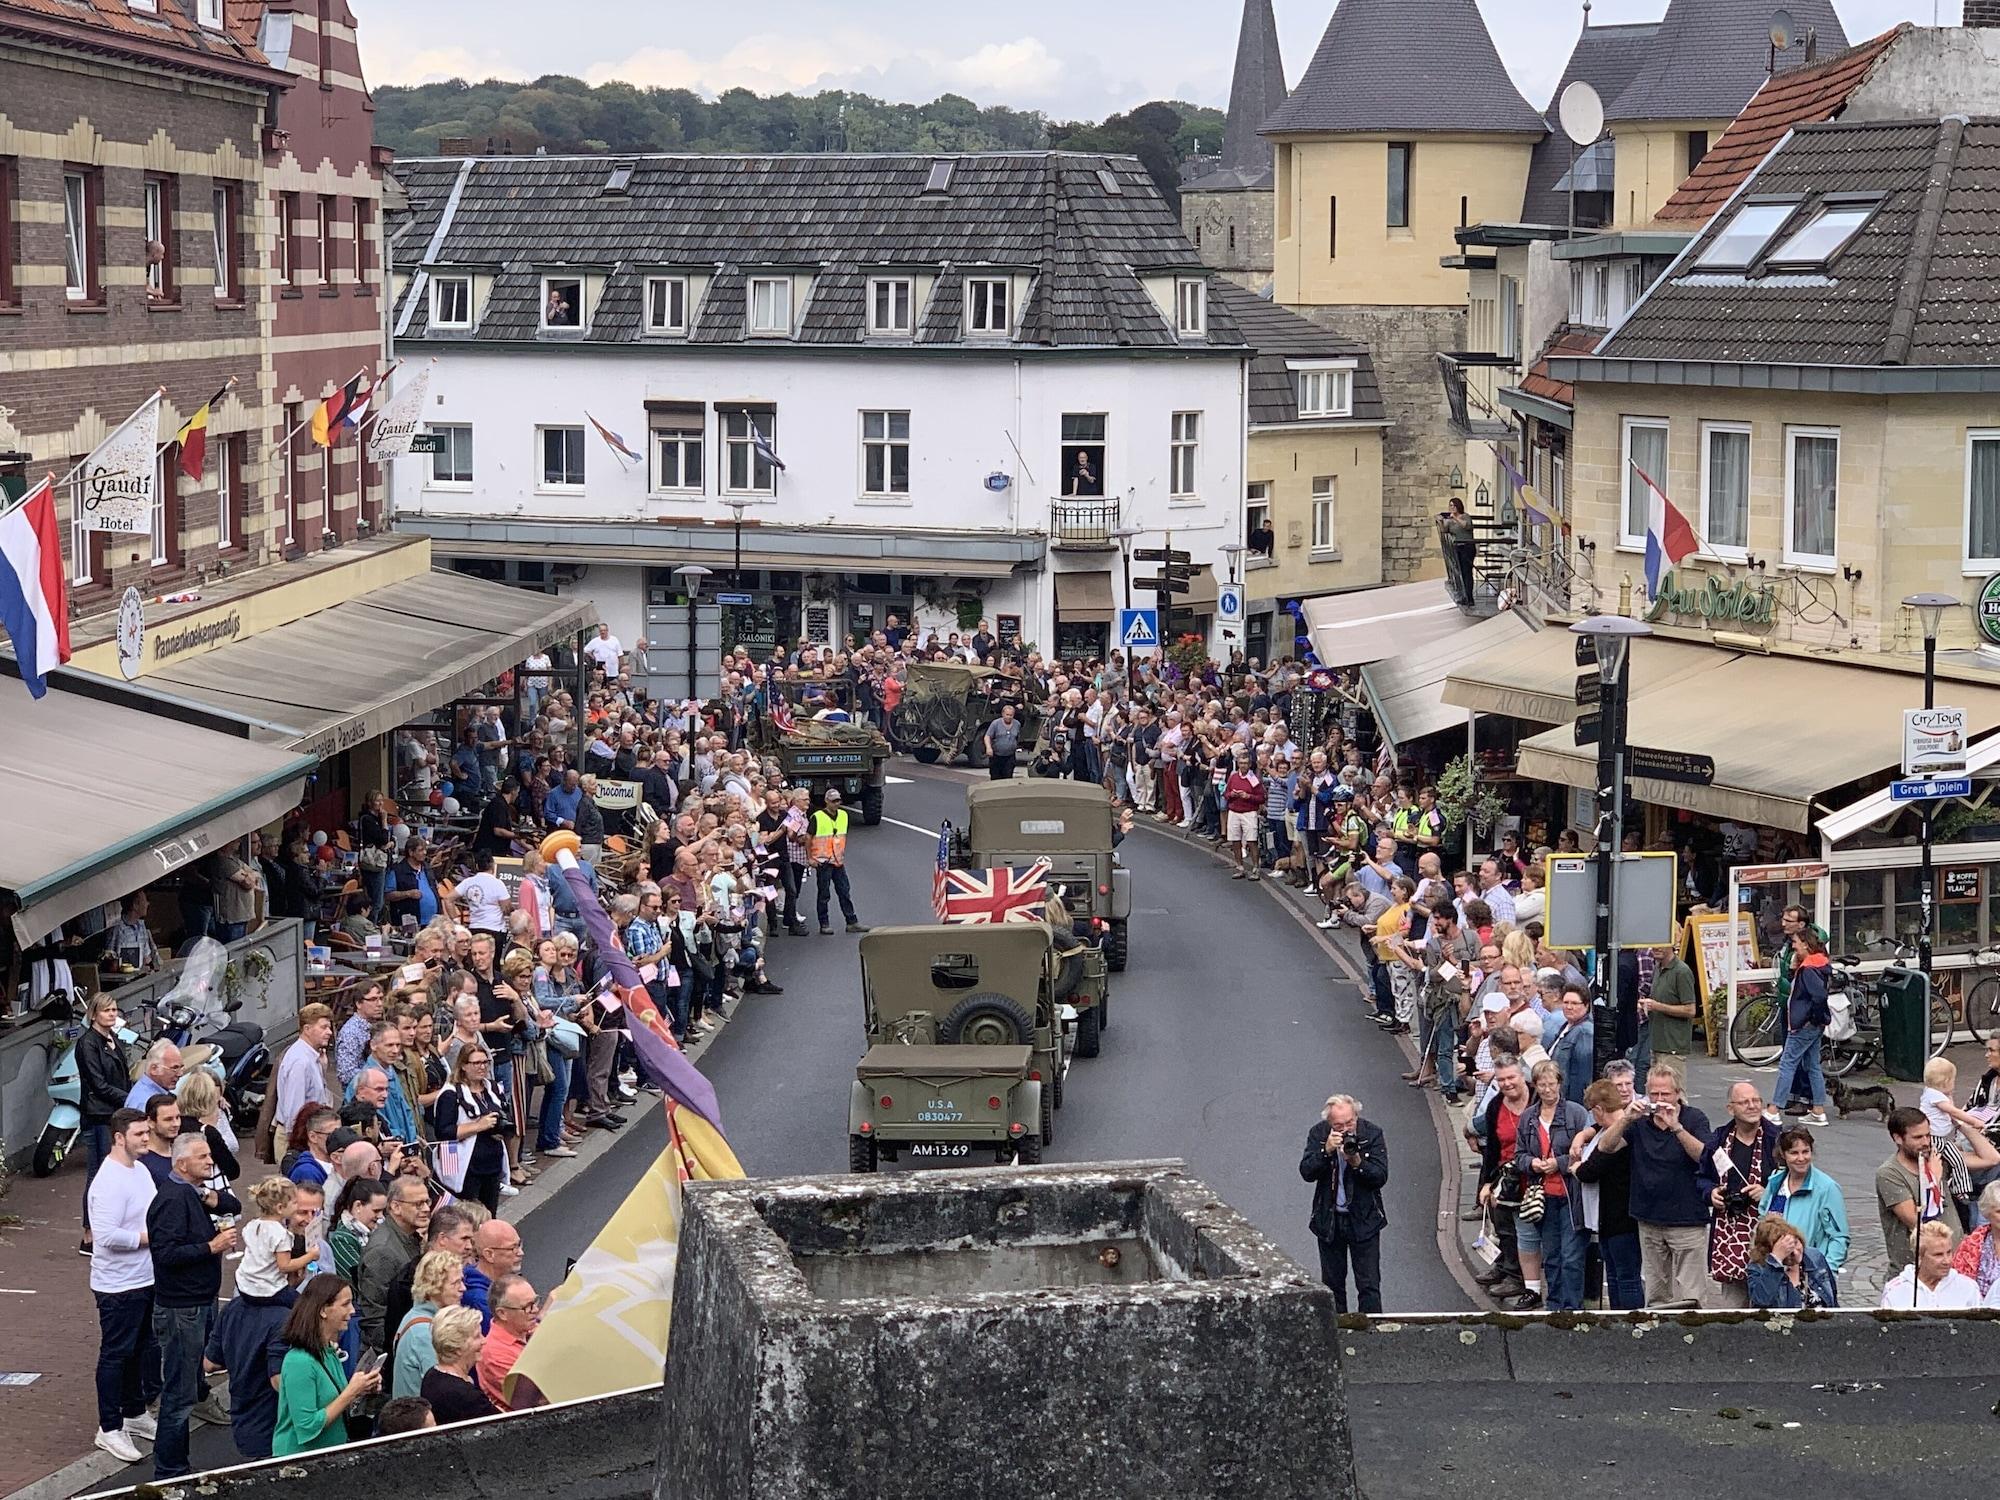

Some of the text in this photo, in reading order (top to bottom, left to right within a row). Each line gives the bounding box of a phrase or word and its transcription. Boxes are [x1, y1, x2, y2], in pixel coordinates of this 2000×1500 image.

[378, 450, 398, 460] Hotel
[85, 466, 151, 511] Gaudí
[99, 516, 133, 530] Hotel
[1643, 569, 1696, 621] Au
[1900, 781, 1963, 795] Grenlplein
[917, 1111, 963, 1122] 0830477
